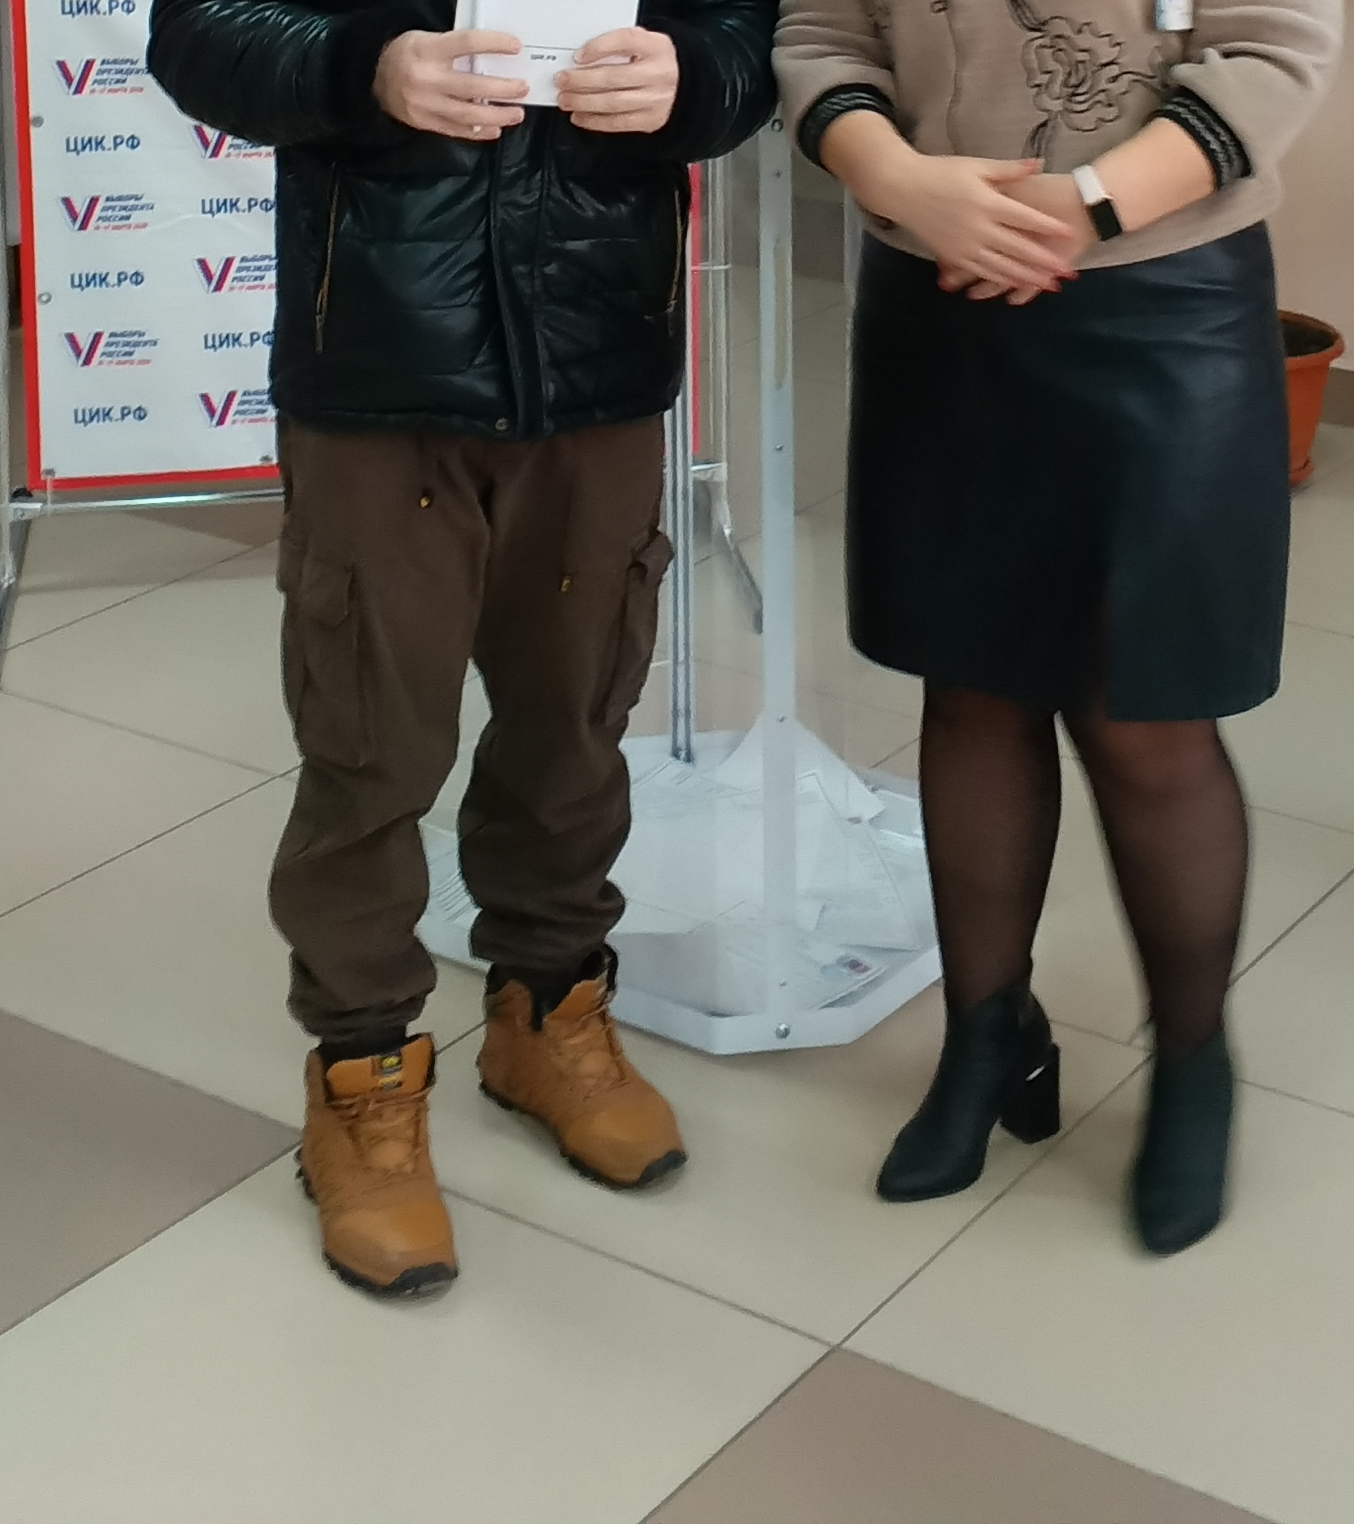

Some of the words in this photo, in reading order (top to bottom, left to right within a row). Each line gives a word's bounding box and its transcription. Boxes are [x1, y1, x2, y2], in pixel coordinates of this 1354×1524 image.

[65, 134, 140, 156] ЦИК.РФ
[70, 271, 144, 291] ЦИК.РФ
[73, 405, 148, 427] ЦИК.РФ
